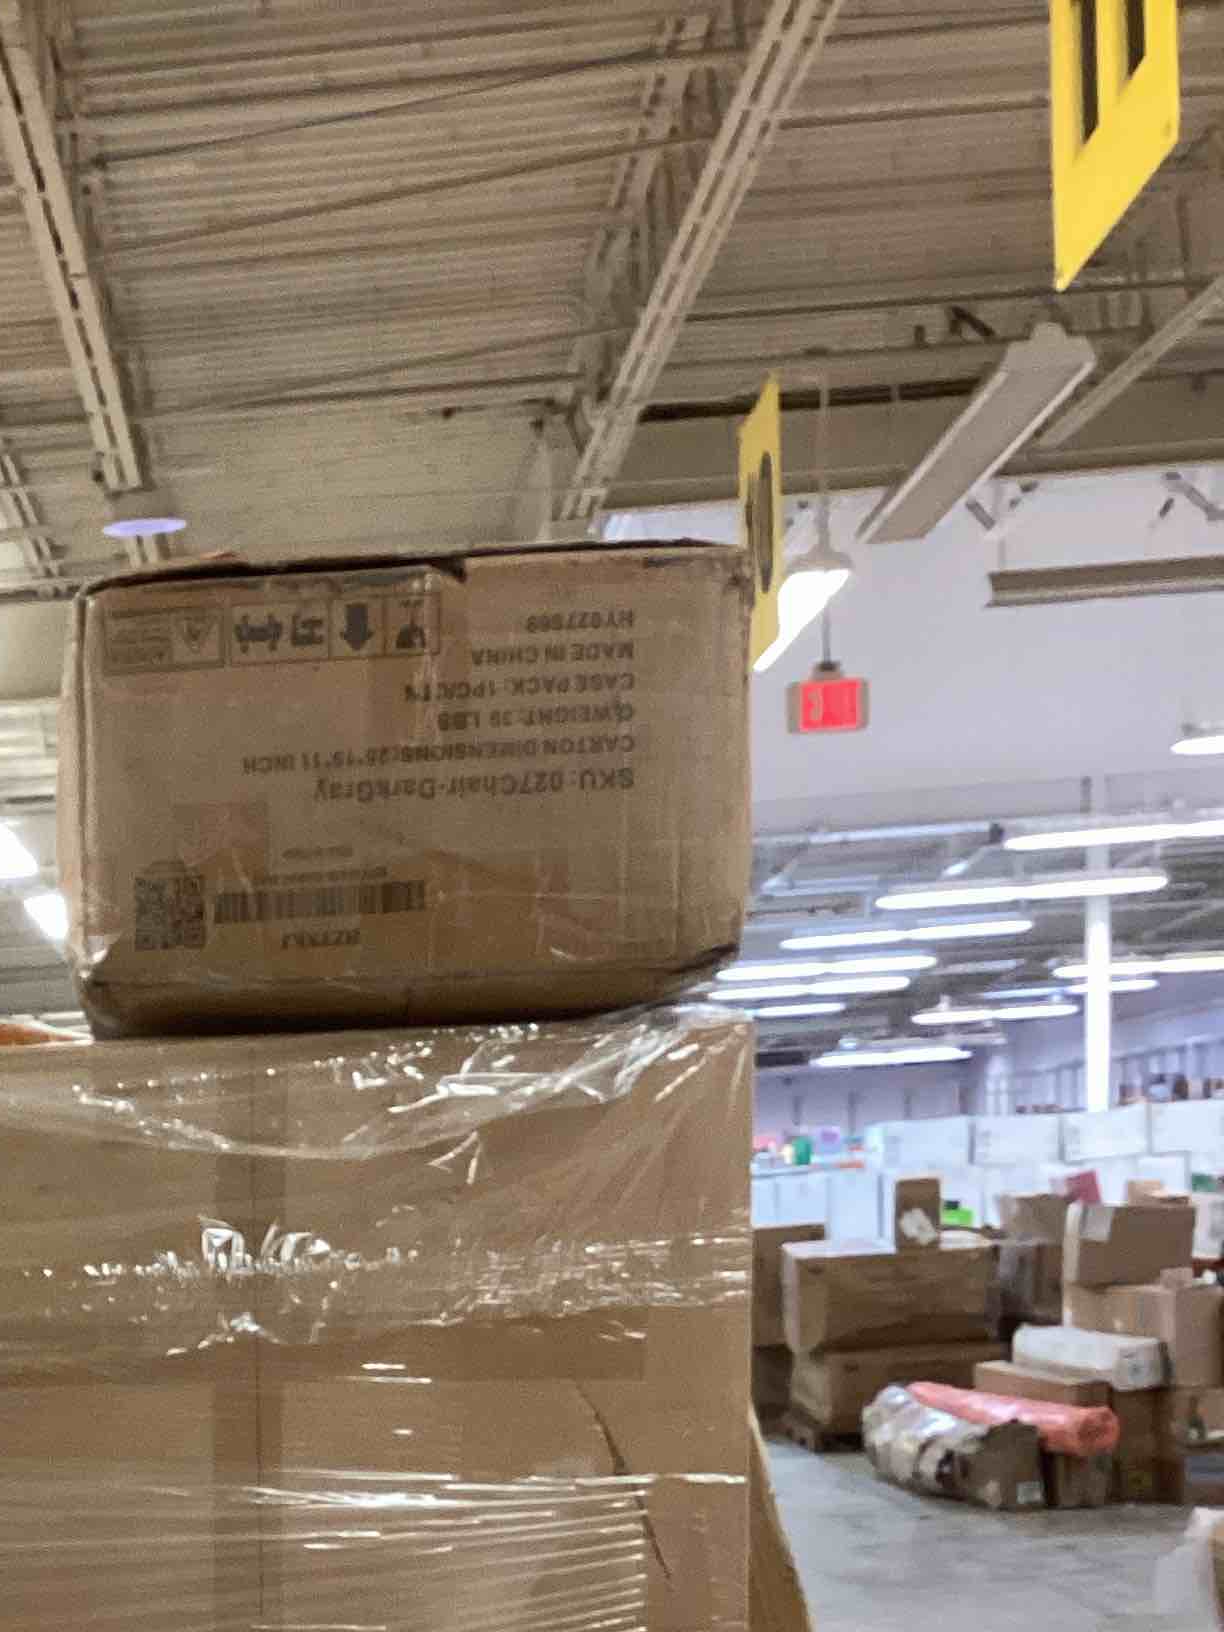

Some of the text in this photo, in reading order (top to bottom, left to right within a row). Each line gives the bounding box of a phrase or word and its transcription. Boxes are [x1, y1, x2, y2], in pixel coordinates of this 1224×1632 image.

[471, 641, 634, 667] MADE IN CHINA
[577, 672, 635, 692] CASE
[543, 735, 635, 754] CARTON
[242, 752, 296, 776] INCH
